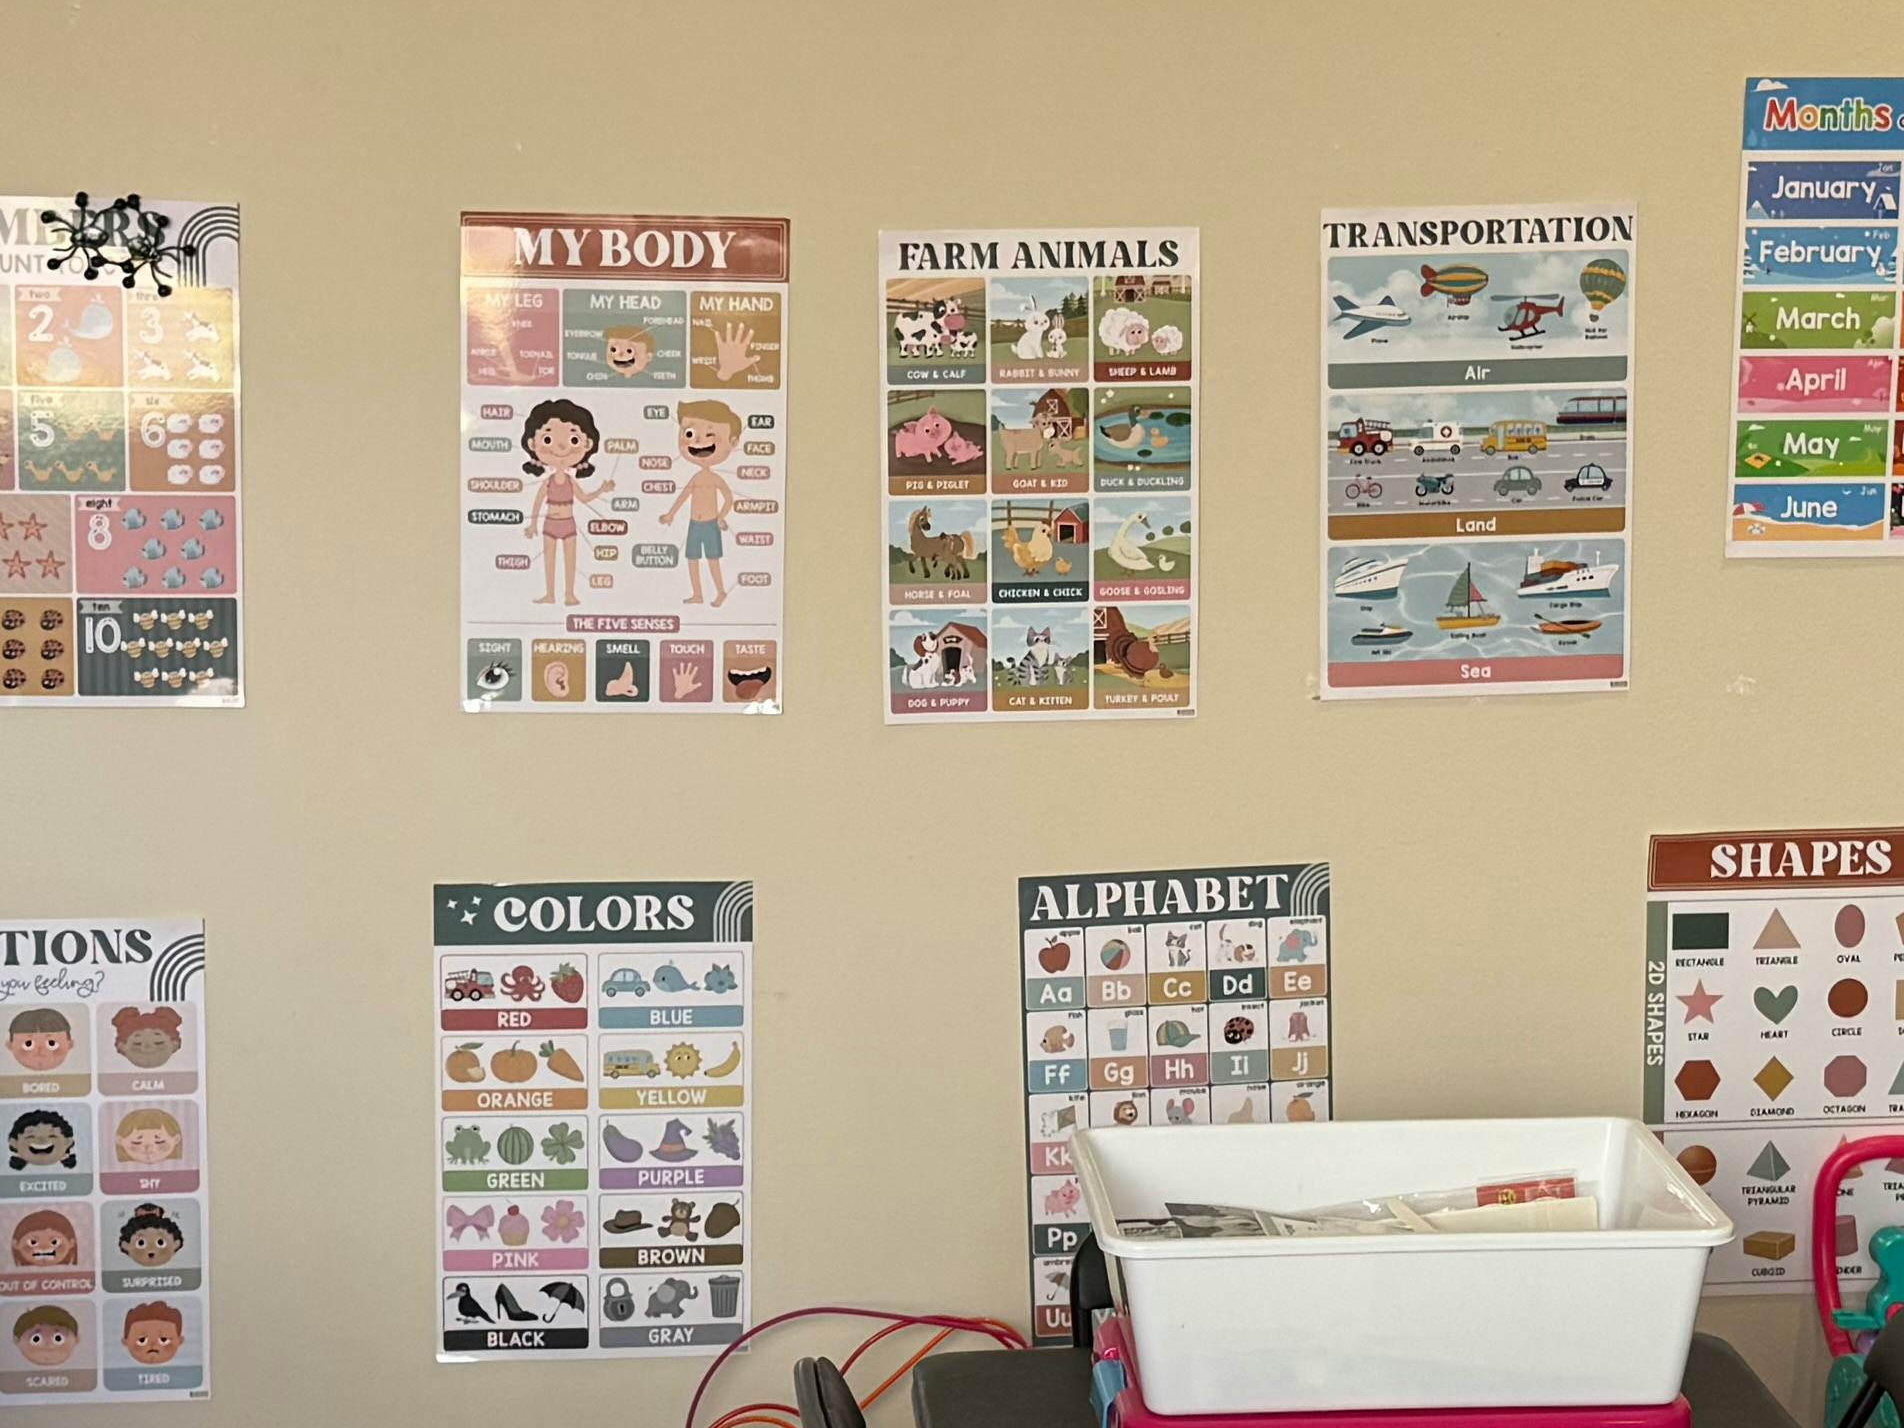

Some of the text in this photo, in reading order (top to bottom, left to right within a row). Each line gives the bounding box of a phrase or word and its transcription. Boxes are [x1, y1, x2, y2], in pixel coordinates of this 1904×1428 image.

[1764, 98, 1893, 132] Months
[1772, 176, 1876, 204] January
[1323, 216, 1633, 248] TRANSPORTATION
[514, 228, 736, 269] MY BODY
[898, 240, 1179, 270] FARM ANIMALS
[1760, 241, 1881, 268] February
[590, 294, 661, 310] MY HEAD
[700, 298, 774, 311] MY HAND
[29, 306, 54, 342] 2
[1776, 307, 1860, 331] March
[1465, 365, 1490, 380] Air
[1786, 368, 1846, 394] April
[30, 412, 54, 447] 5
[141, 412, 166, 448] 6
[752, 418, 772, 427] EAR
[1783, 432, 1840, 460] May
[86, 498, 112, 509] eight
[1781, 496, 1837, 520] June
[472, 512, 519, 522] STOMACH
[88, 514, 112, 550] 8
[591, 523, 624, 533] ELBOW
[1456, 518, 1496, 533] Land
[999, 588, 1082, 598] CHICKEN & CHICK
[573, 618, 674, 630] THE FIVE SENSES
[85, 616, 122, 653] 10
[606, 644, 640, 654] SMELL
[670, 644, 704, 654] TOUCH
[735, 644, 765, 654] TASTE
[1460, 664, 1491, 678] Sea
[1710, 840, 1892, 878] SHAPES
[1030, 874, 1289, 921] ALPHABET
[494, 895, 695, 934] COLORS
[1837, 955, 1861, 963] OVAL
[35, 968, 105, 997] feeling?
[1164, 979, 1192, 997] Cc
[1223, 975, 1252, 995] Dd
[1284, 973, 1312, 991] Ee
[1040, 984, 1072, 1003] Aa
[1102, 981, 1131, 1000] Bb
[497, 1012, 531, 1028] RED
[649, 1010, 693, 1025] BLUE
[1647, 961, 1666, 1066] 2D SHAPES
[1761, 1030, 1788, 1039] HEART
[1832, 1027, 1862, 1037] CIRCLE
[1165, 1060, 1194, 1079] Hh
[1231, 1056, 1248, 1074] Ii
[1292, 1052, 1308, 1074] Jj
[1046, 1065, 1070, 1084] Ff
[1104, 1063, 1134, 1084] Gg
[23, 1082, 59, 1093] BORED
[132, 1080, 164, 1090] CALM
[477, 1092, 553, 1108] ORANGE
[636, 1090, 707, 1105] YELLOW
[1750, 1106, 1794, 1117] DIAMOND
[1823, 1104, 1866, 1114] OCTAGON
[20, 1180, 66, 1191] EXCITED
[487, 1173, 545, 1188] GREEN
[638, 1170, 704, 1185] PURPLE
[492, 1253, 539, 1268] PINK
[637, 1248, 705, 1264] BROWN
[122, 1275, 182, 1288] SURPRISED
[487, 1331, 545, 1347] BLACK
[649, 1328, 694, 1344] GRAY
